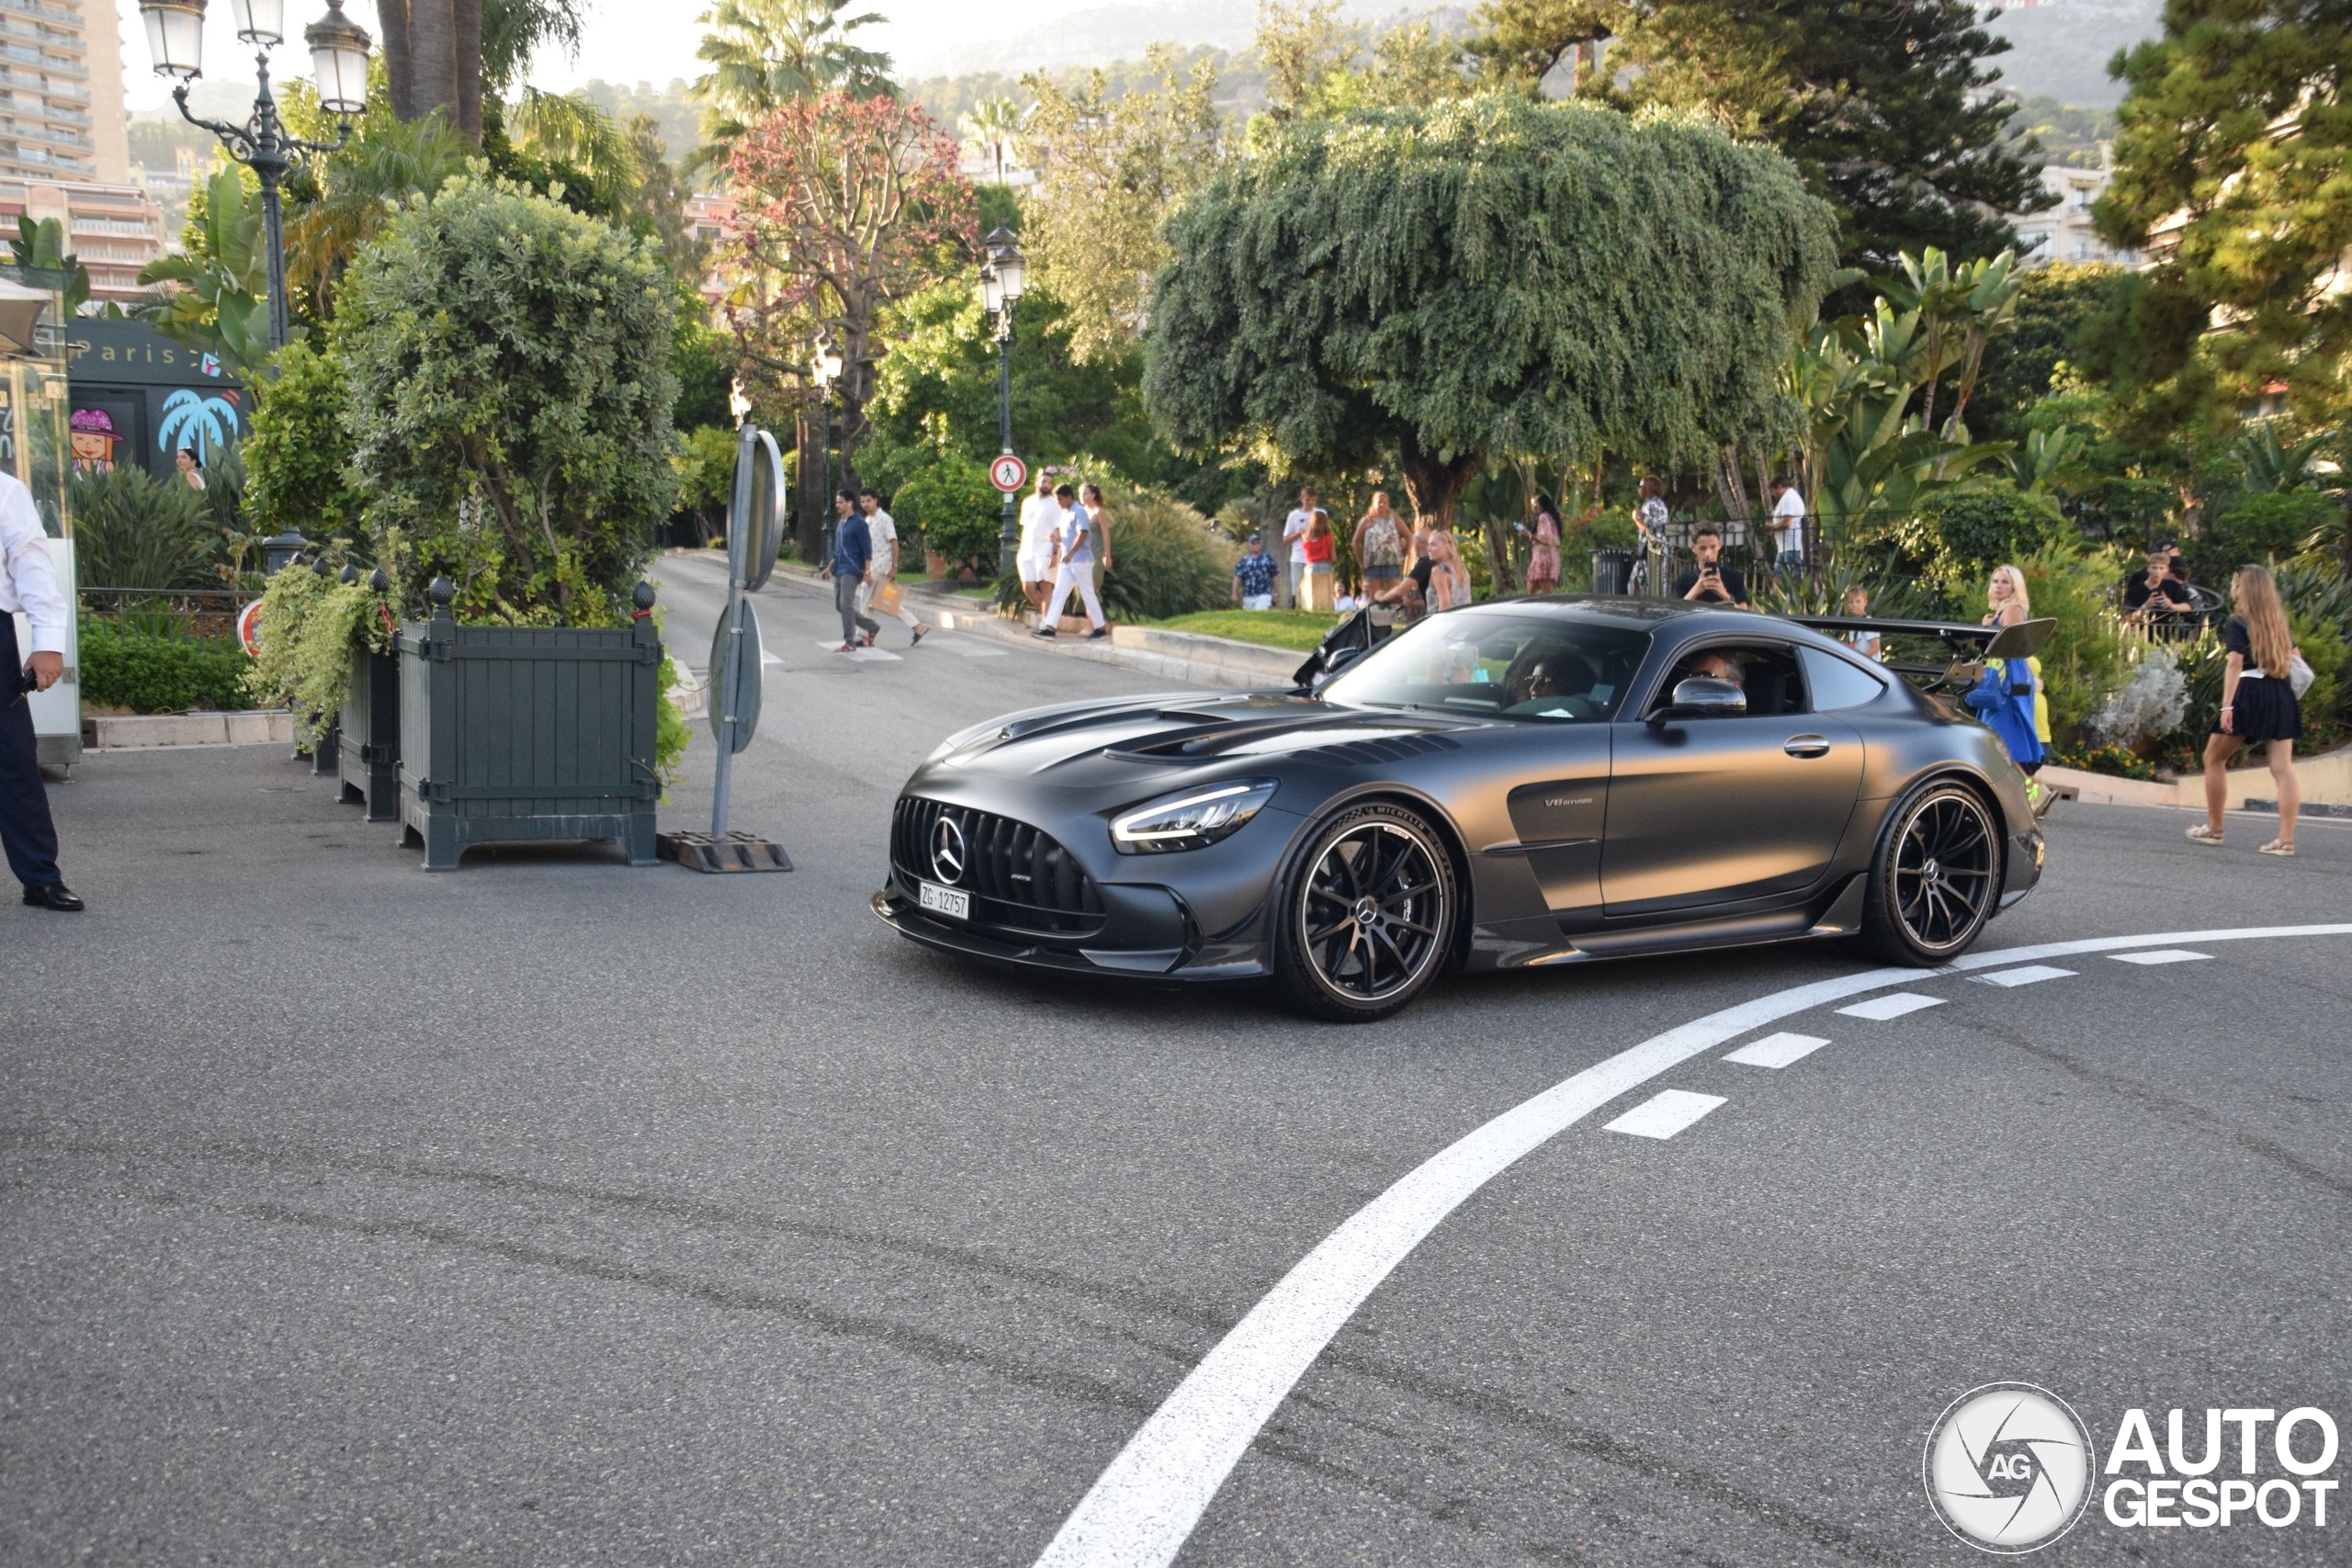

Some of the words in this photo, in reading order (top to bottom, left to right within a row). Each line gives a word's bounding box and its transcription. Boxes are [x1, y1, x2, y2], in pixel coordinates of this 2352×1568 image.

[75, 340, 175, 364] Paris
[1544, 798, 1562, 807] V8
[1376, 806, 1425, 831] MICHELIN
